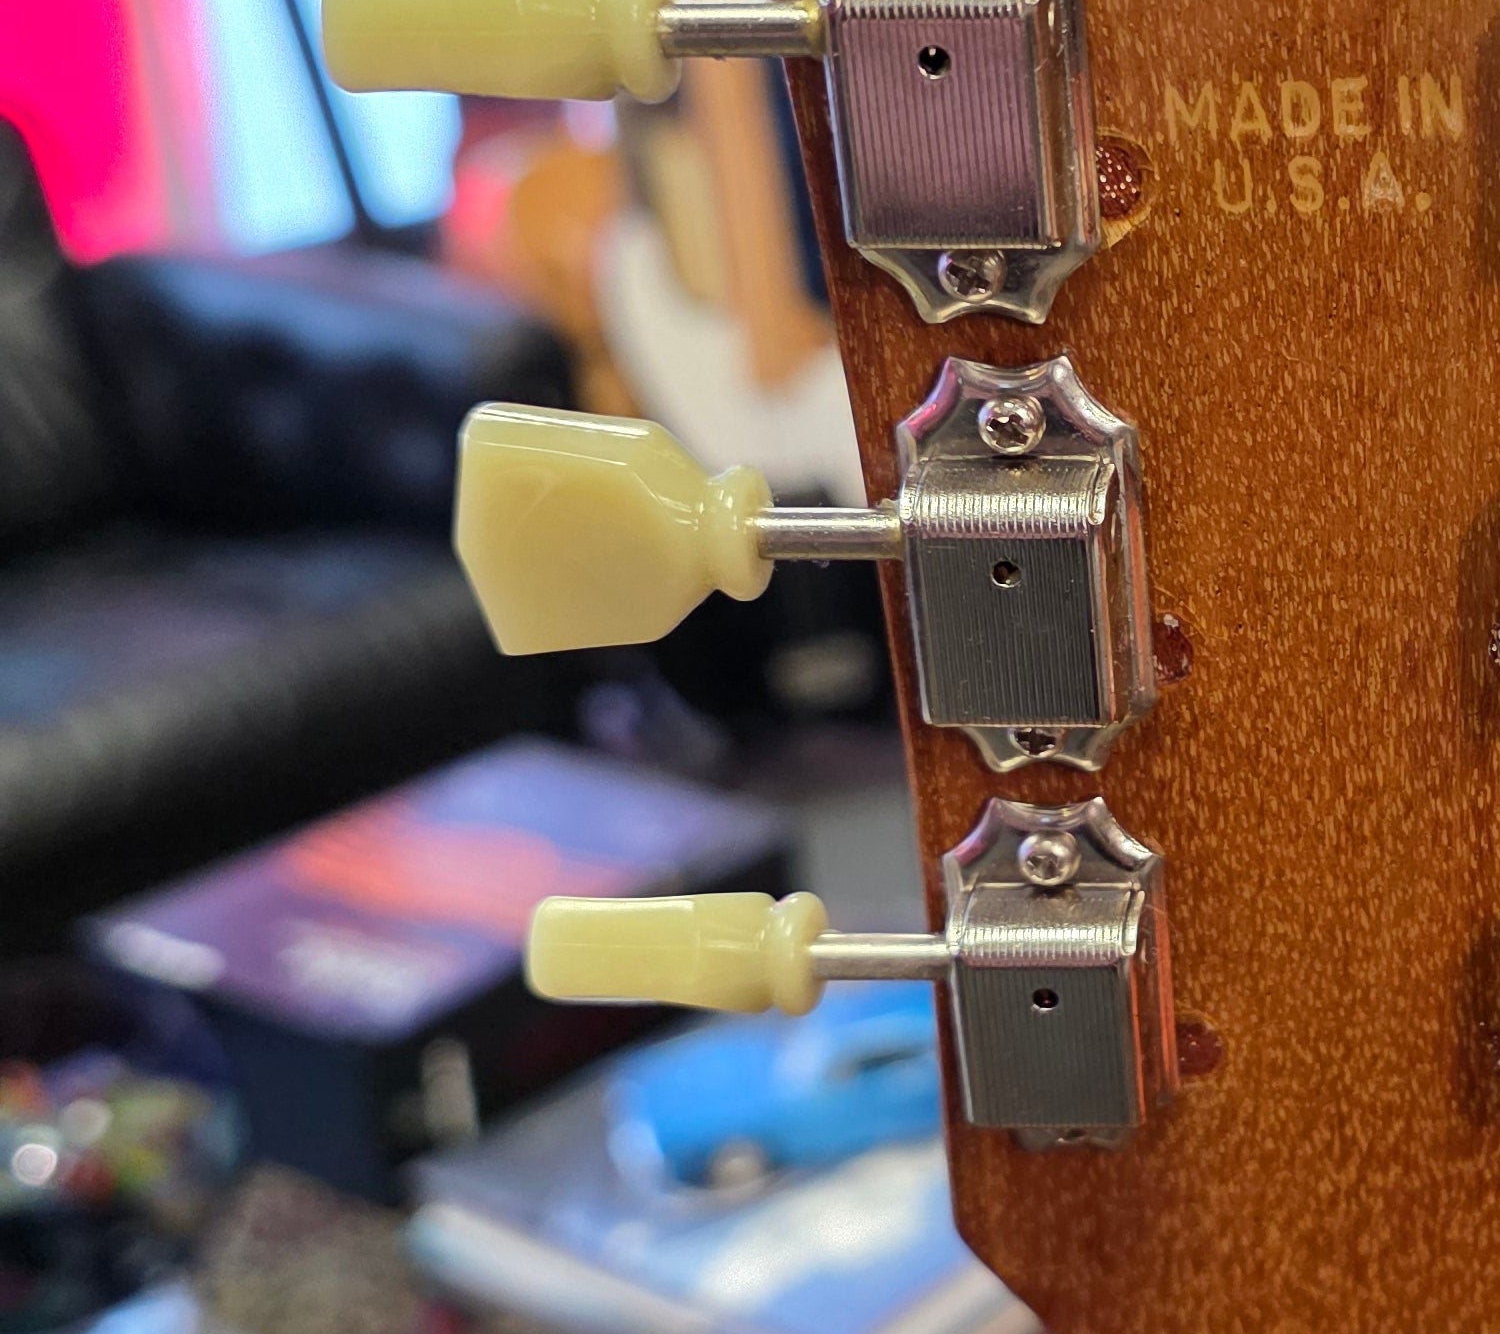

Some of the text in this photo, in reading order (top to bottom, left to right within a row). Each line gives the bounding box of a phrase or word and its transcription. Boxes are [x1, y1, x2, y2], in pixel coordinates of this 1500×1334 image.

[1163, 73, 1466, 143] MADE IN
[1213, 152, 1434, 215] U.S.A.
